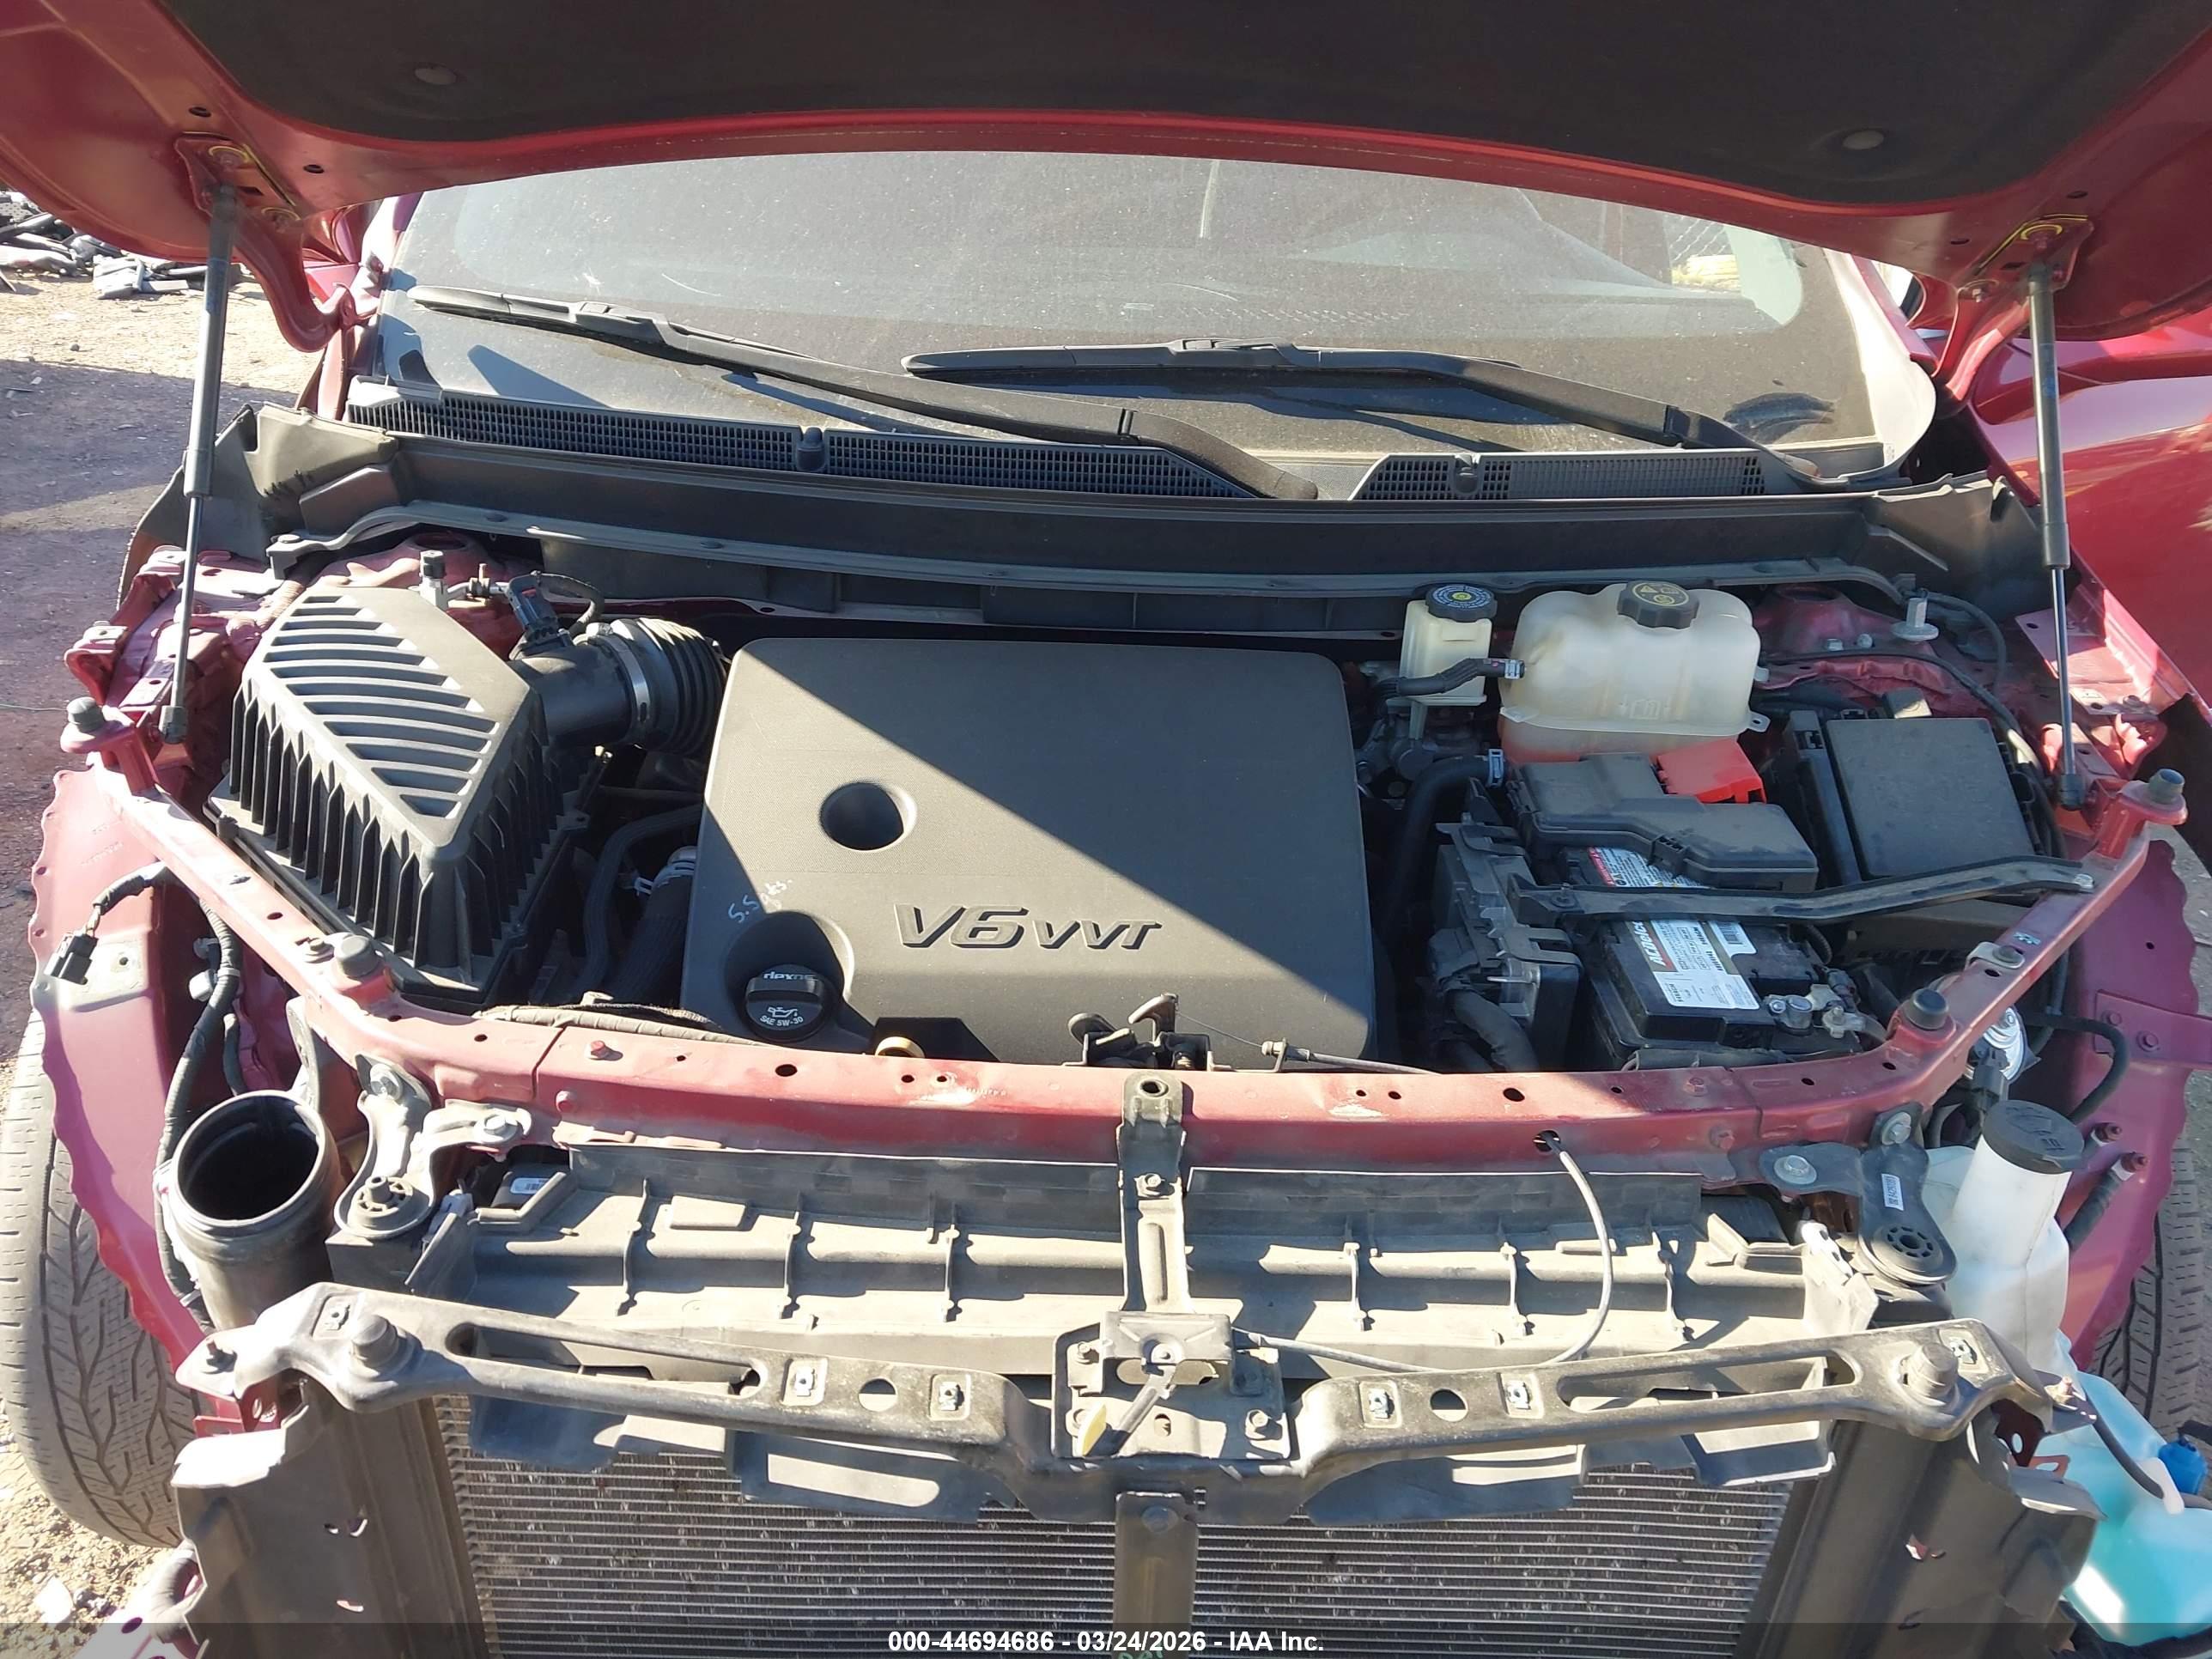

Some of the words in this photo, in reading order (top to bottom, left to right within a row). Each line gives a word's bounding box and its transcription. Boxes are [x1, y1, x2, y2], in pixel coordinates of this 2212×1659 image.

[894, 903, 1030, 949] V6
[1032, 920, 1162, 950] VVT
[759, 1015, 776, 1026] SAE
[777, 1016, 804, 1027] 5W-30
